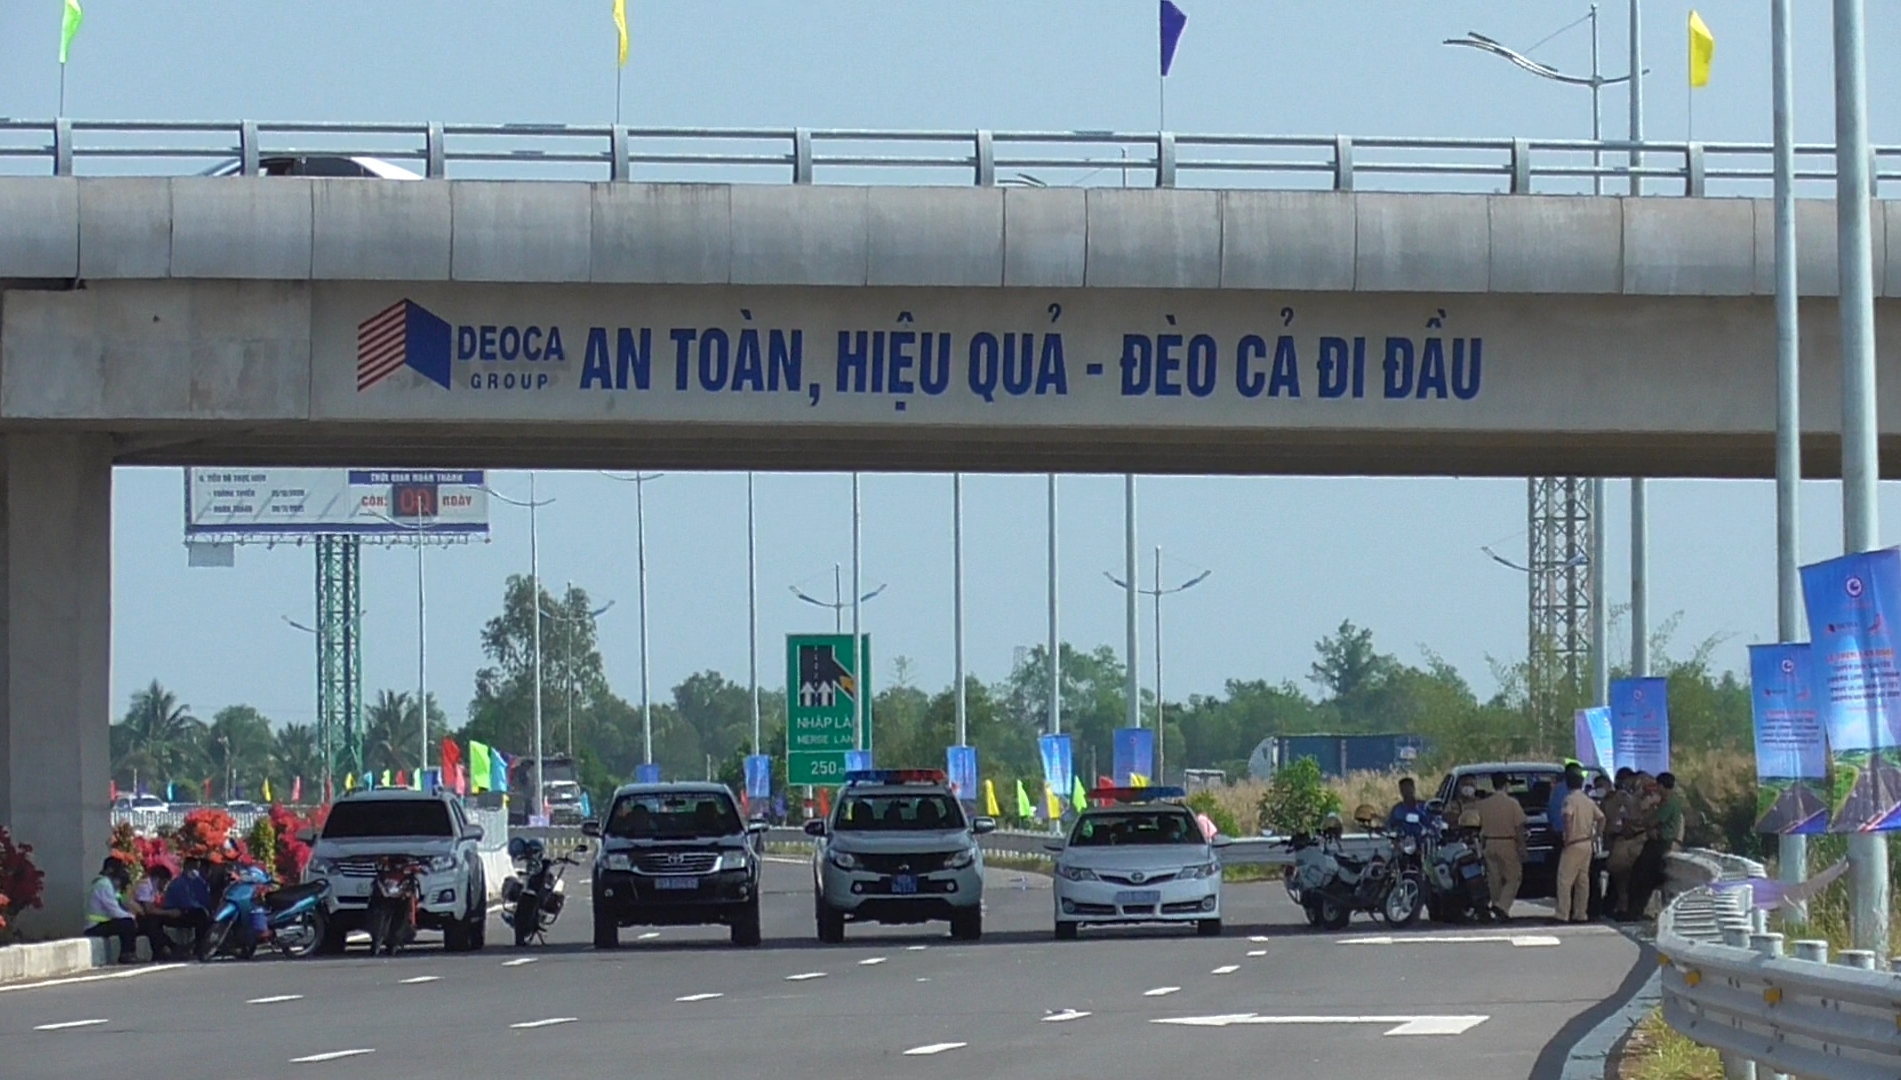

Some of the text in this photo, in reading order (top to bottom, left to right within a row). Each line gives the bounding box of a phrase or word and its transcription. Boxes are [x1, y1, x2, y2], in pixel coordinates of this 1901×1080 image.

[457, 325, 566, 362] DEOCA
[582, 303, 1482, 410] AN TOÀN, HIỆU QUẢ - ĐÈO CẢ ĐI ĐẦU
[470, 372, 549, 390] GROUP
[797, 714, 854, 731] NHẬP LÀ
[810, 760, 837, 776] 250
